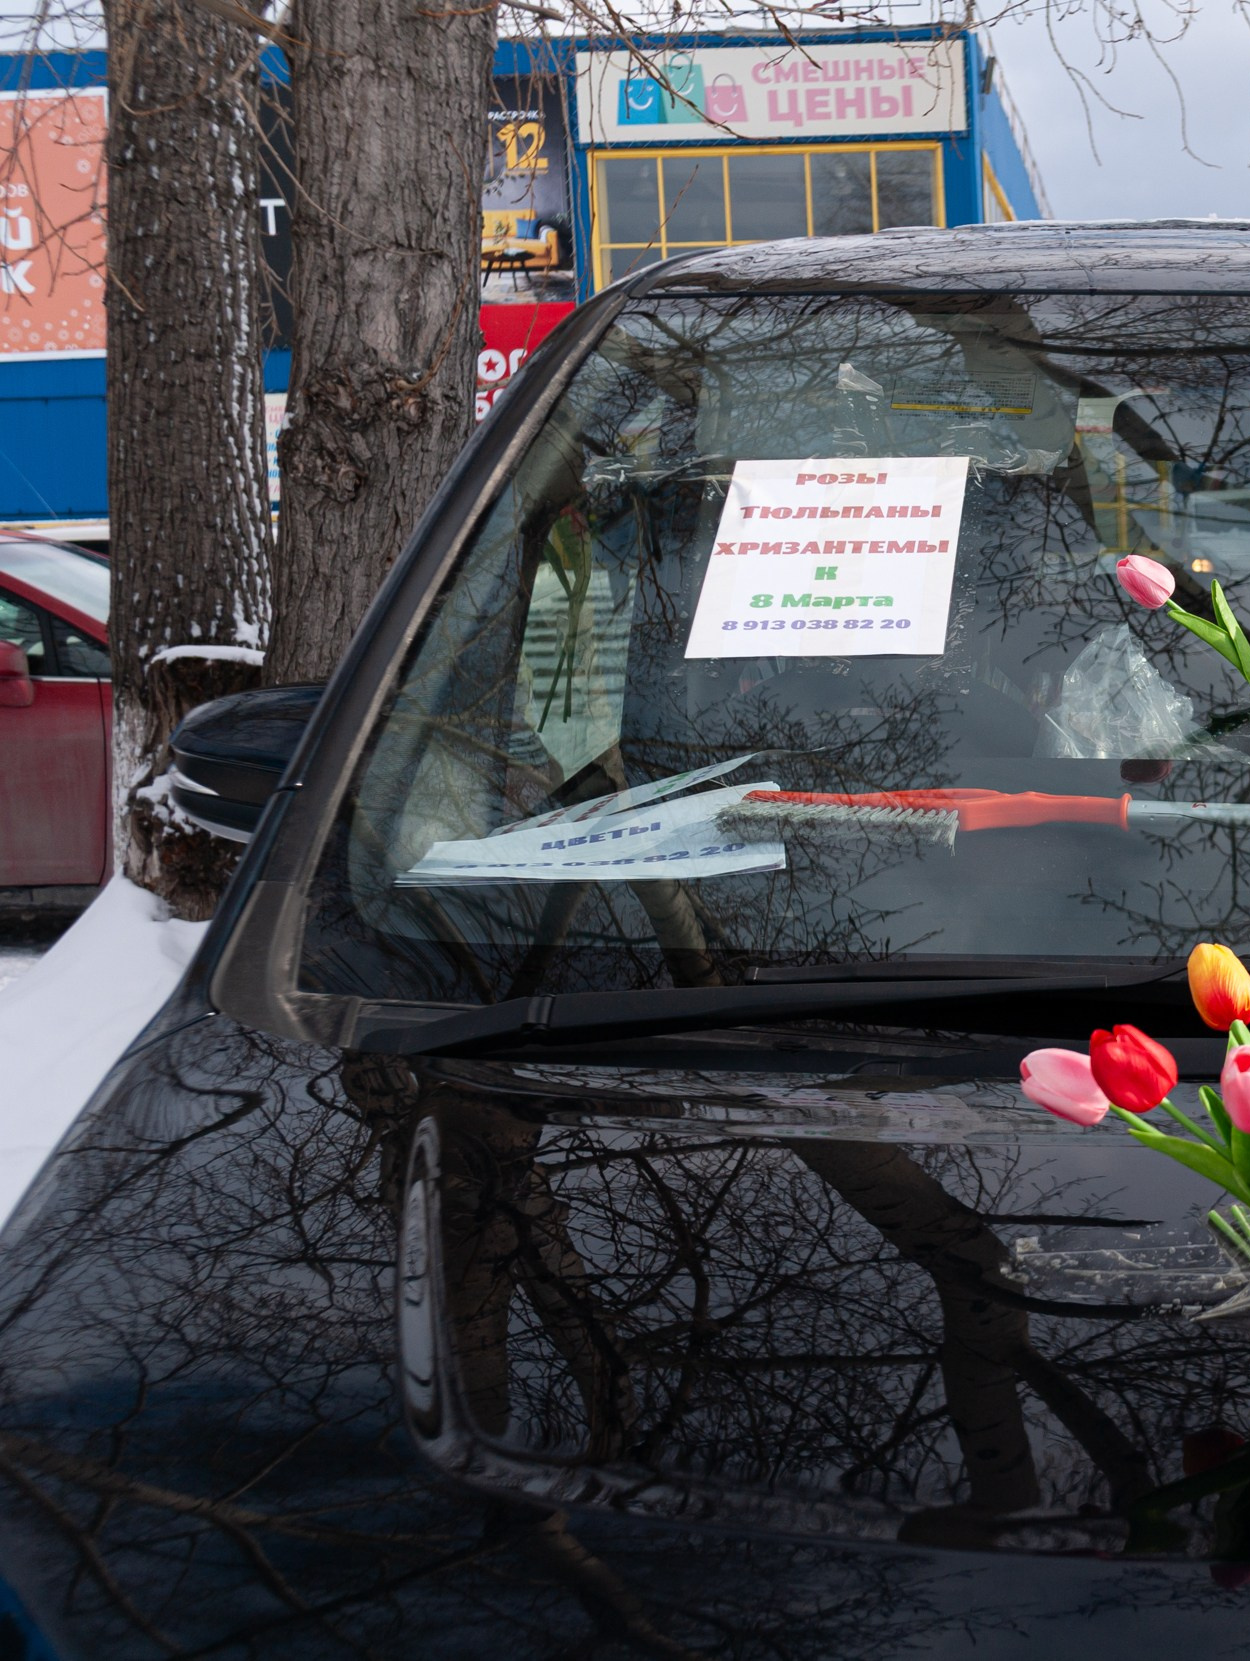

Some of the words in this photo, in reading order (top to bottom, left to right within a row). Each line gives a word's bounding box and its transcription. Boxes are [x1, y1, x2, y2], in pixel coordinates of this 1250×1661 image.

[751, 57, 927, 85] СМЕШНЫЕ
[767, 85, 914, 127] ЦЕНЫ
[496, 122, 549, 170] 12
[796, 472, 888, 486] РОЗЫ
[739, 505, 942, 519] ТЮЛЬПАНЫ
[713, 540, 950, 555] ХРИЗАНТЕМЫ
[749, 593, 773, 608] 8
[780, 593, 894, 610] Марта
[721, 620, 738, 631] 8
[743, 620, 786, 630] 913
[790, 619, 838, 630] 038
[843, 619, 874, 629] 82
[880, 619, 911, 629] 20
[540, 822, 661, 851] ЦВЕТЫ
[642, 850, 690, 864] 82
[699, 842, 746, 857] 20
